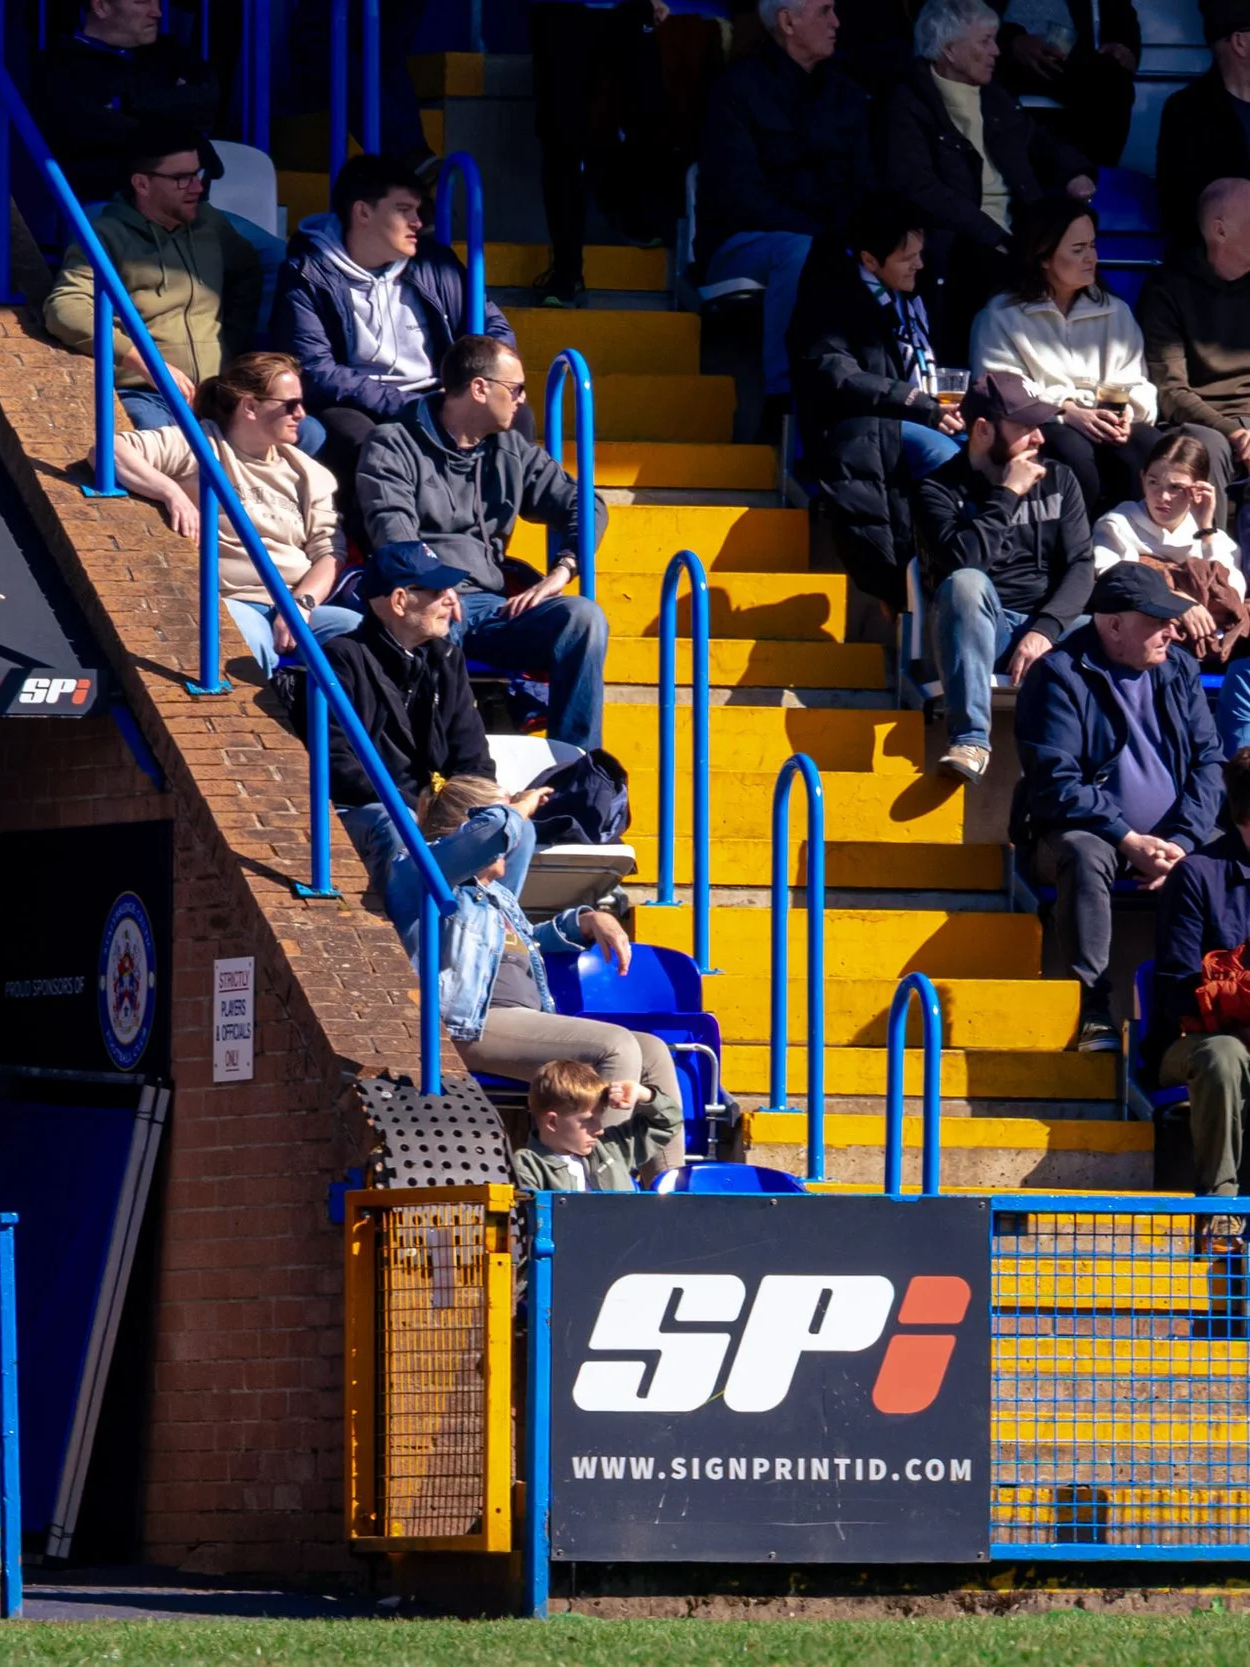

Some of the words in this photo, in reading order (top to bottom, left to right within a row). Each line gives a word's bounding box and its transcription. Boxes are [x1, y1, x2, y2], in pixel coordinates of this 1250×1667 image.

[219, 970, 249, 989] STRICTLY
[221, 999, 246, 1017] PLAYERS
[222, 1022, 251, 1041] OFFICIALS
[225, 1049, 240, 1067] ONLY
[571, 1456, 973, 1482] WWW.SIGNPRINTID.COM
